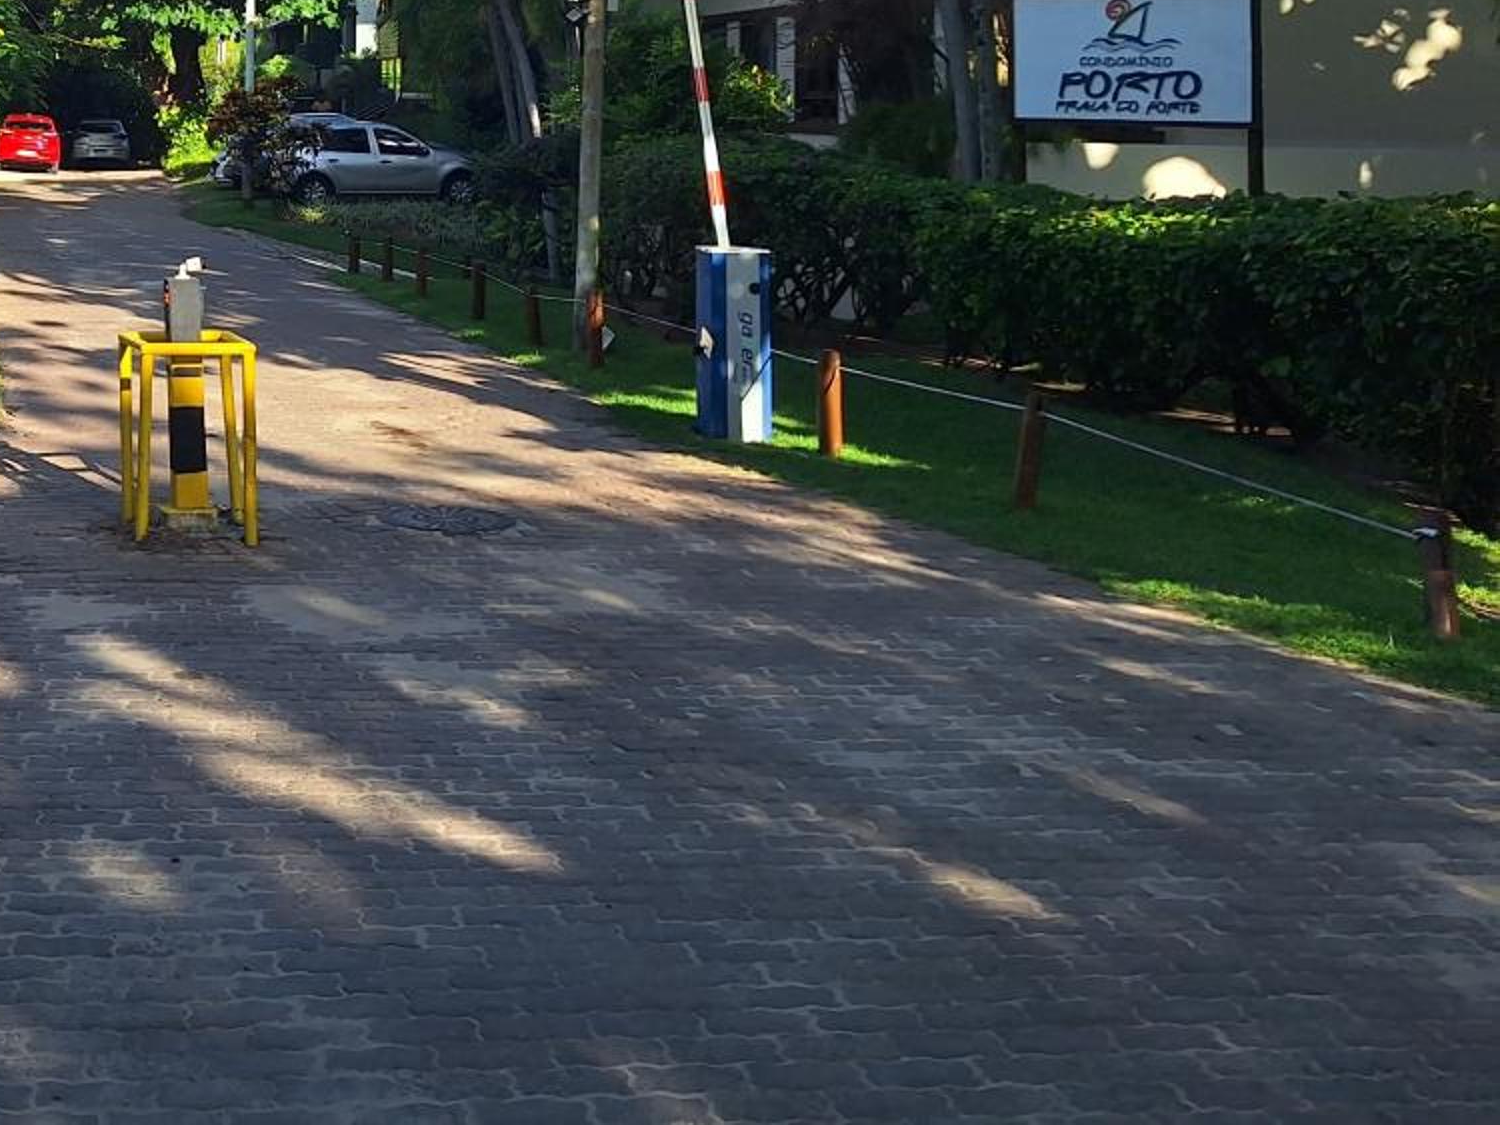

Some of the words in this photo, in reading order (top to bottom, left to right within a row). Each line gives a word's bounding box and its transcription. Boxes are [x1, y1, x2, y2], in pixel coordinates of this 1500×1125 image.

[1058, 71, 1202, 102] PORTO
[1056, 101, 1110, 113] PRAIA
[1115, 100, 1140, 113] DO
[1146, 100, 1202, 116] FORTE
